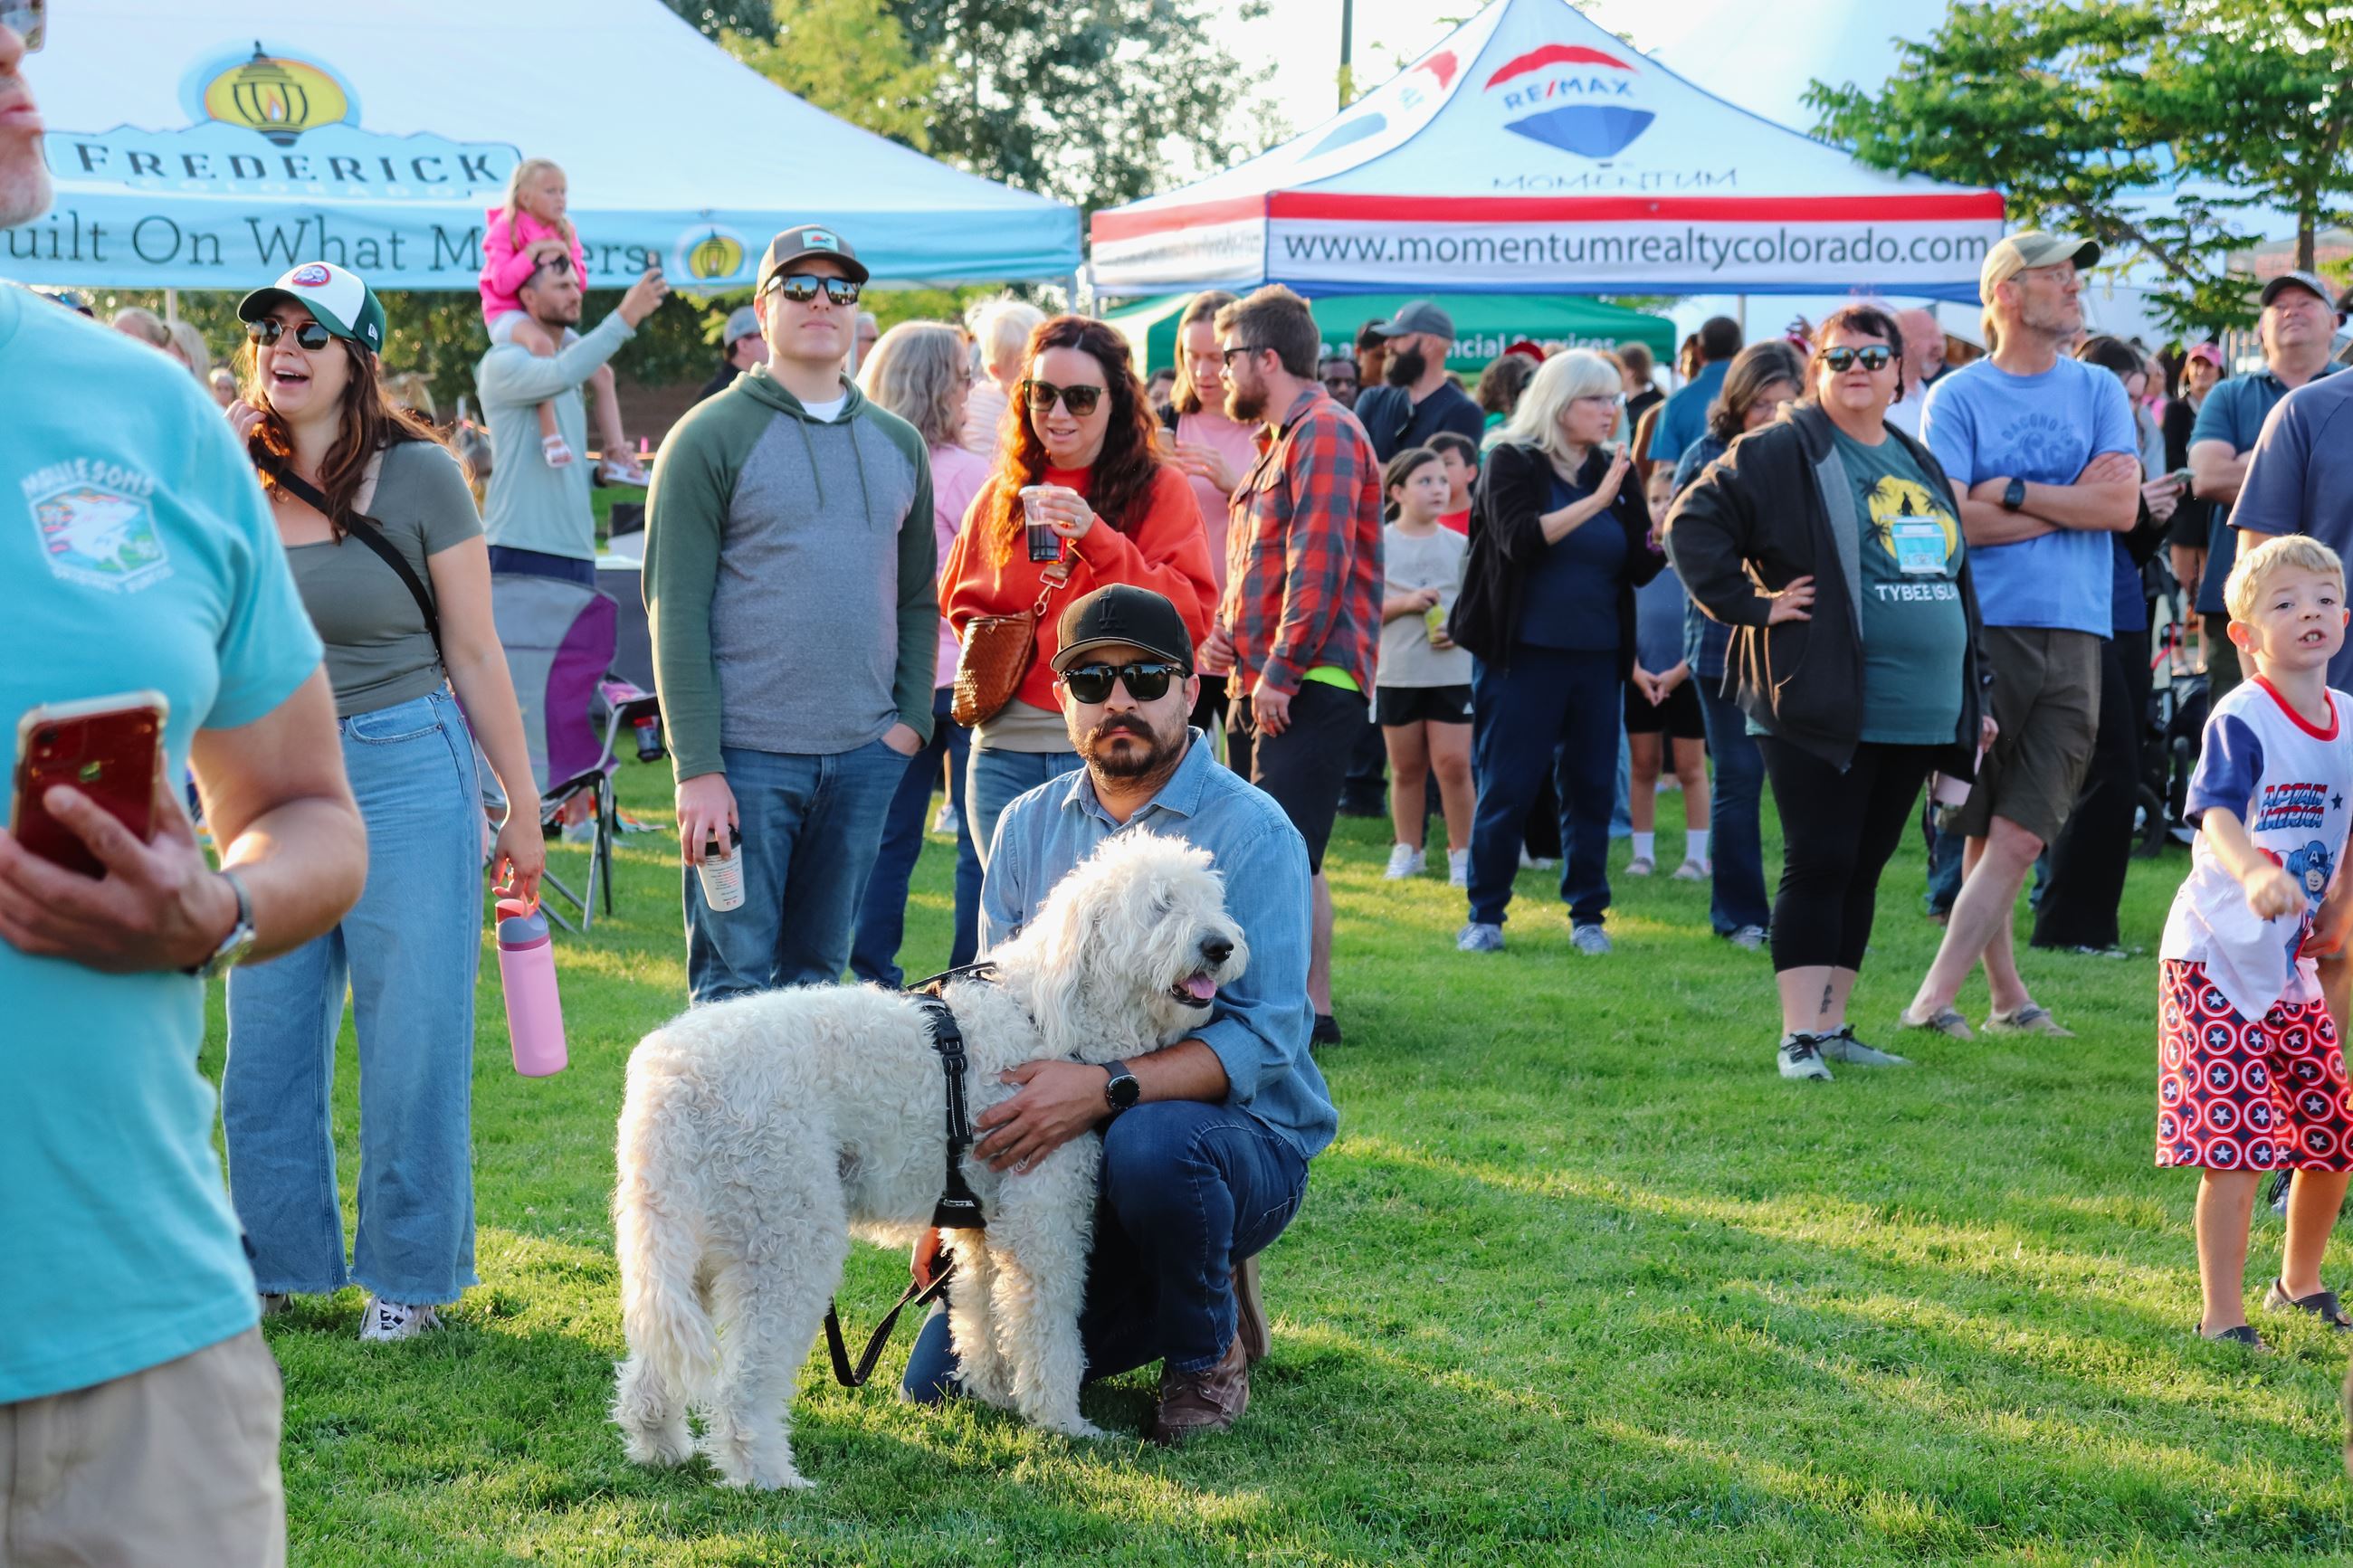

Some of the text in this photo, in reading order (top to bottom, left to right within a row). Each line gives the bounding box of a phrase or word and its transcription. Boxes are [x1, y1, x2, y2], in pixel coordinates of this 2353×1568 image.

[1503, 77, 1634, 109] RE/MAX
[73, 142, 500, 183] FREDERICK
[1493, 167, 1738, 190] MOMENTUM
[7, 210, 109, 262] uilt
[133, 214, 224, 265] On
[243, 214, 406, 271] What
[1285, 226, 1988, 271] www.momentumrealtycolorado.com
[1874, 584, 1933, 602] TYBEE
[2262, 784, 2328, 808] APTAIN
